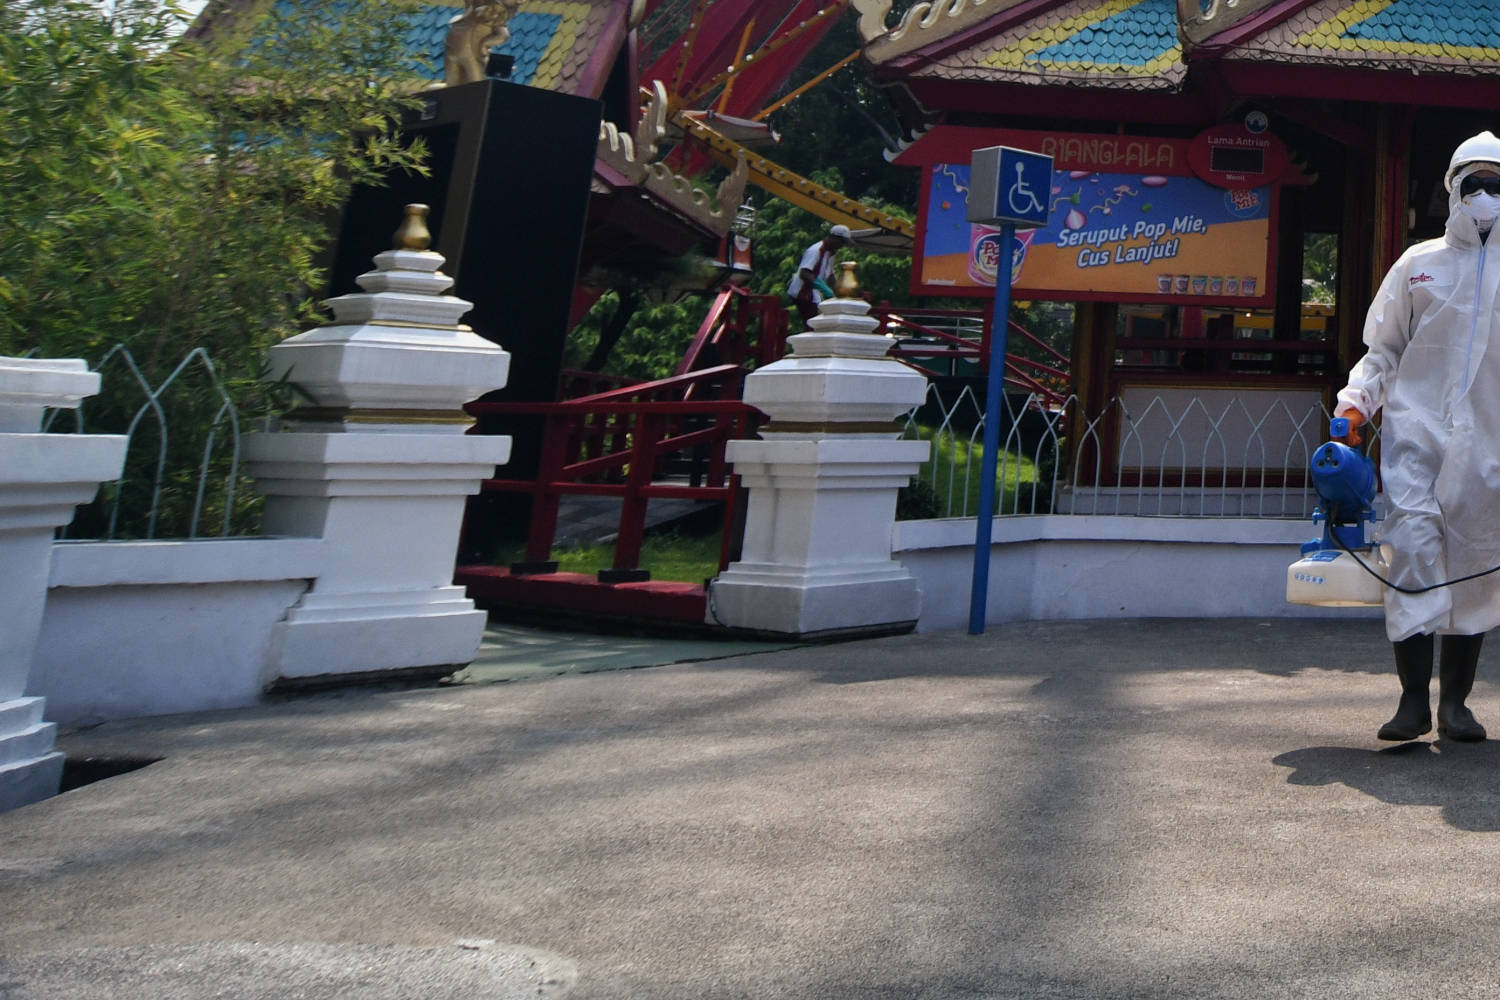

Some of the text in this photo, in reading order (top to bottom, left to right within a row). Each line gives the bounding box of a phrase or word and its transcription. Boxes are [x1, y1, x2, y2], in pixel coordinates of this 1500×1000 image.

[1208, 135, 1271, 147] Lama Antrian
[1057, 215, 1207, 249] Seruput Pop Mie,
[1078, 238, 1179, 268] Cus Lanjut!
